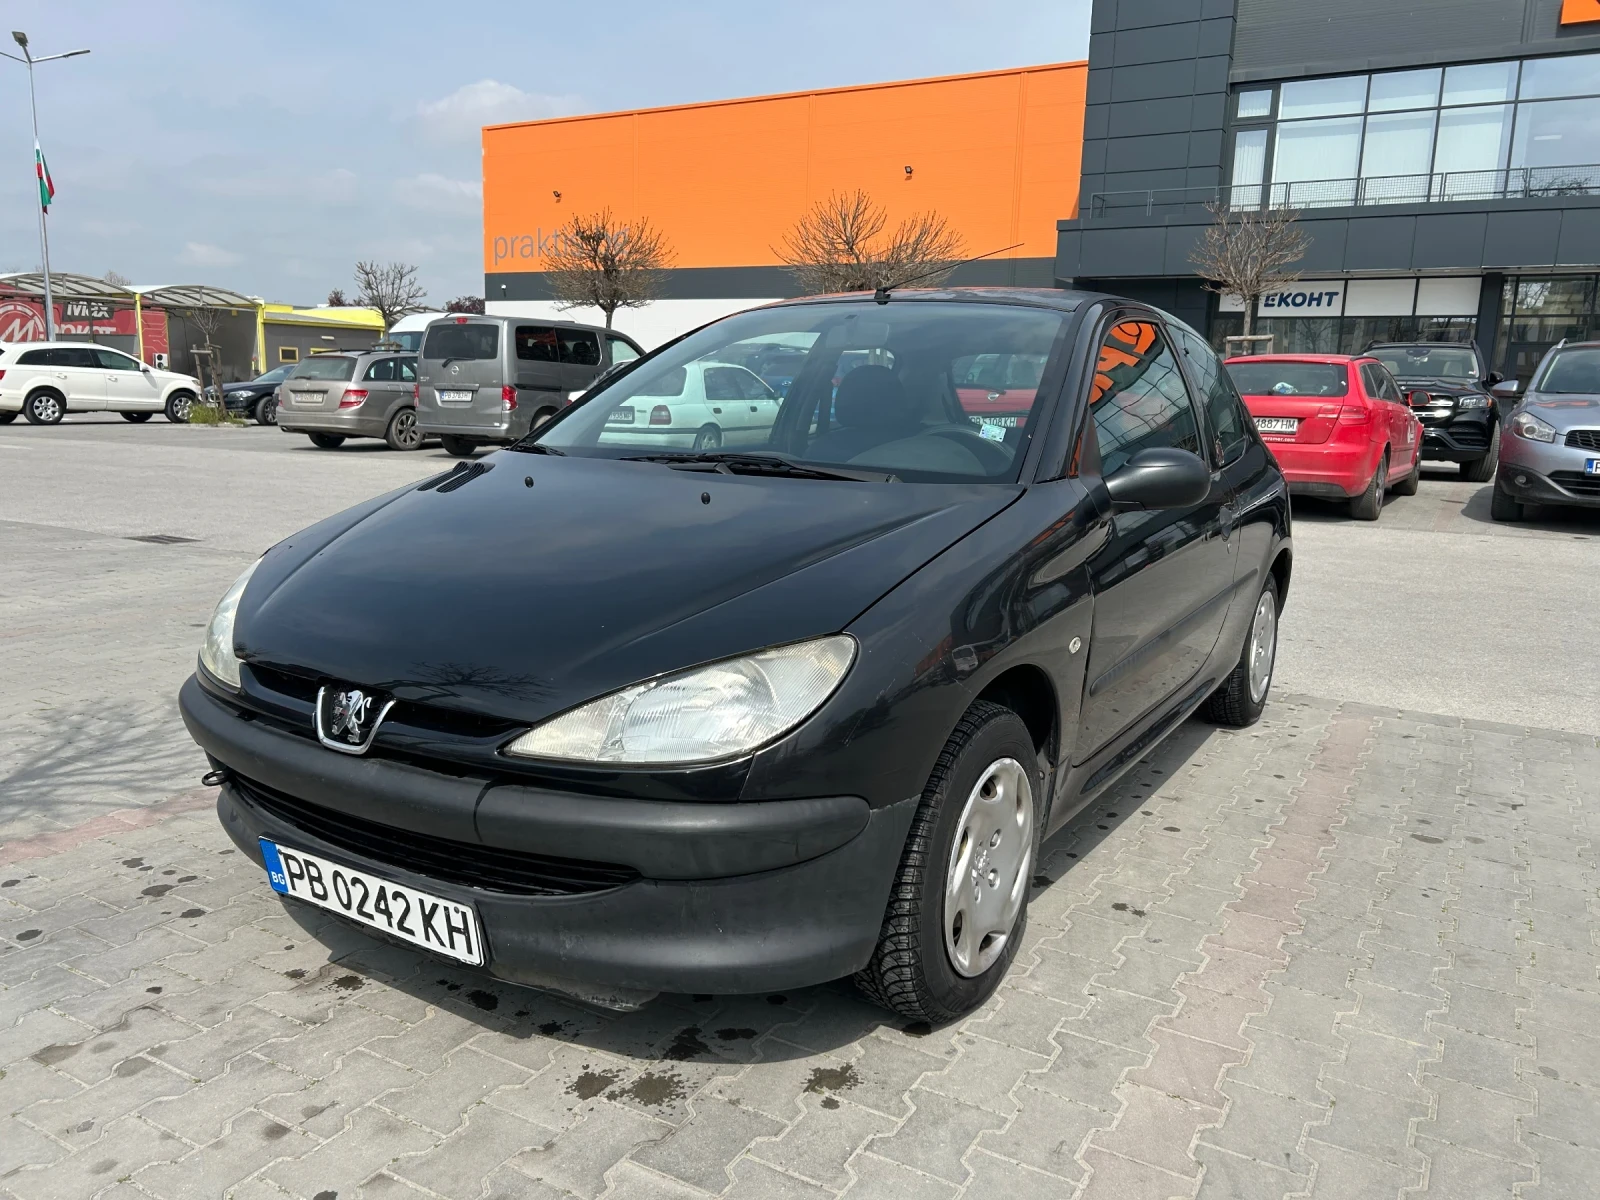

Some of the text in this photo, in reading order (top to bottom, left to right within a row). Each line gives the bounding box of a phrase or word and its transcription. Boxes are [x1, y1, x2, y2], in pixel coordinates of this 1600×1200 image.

[271, 852, 474, 955] BG PB 0242 KH
